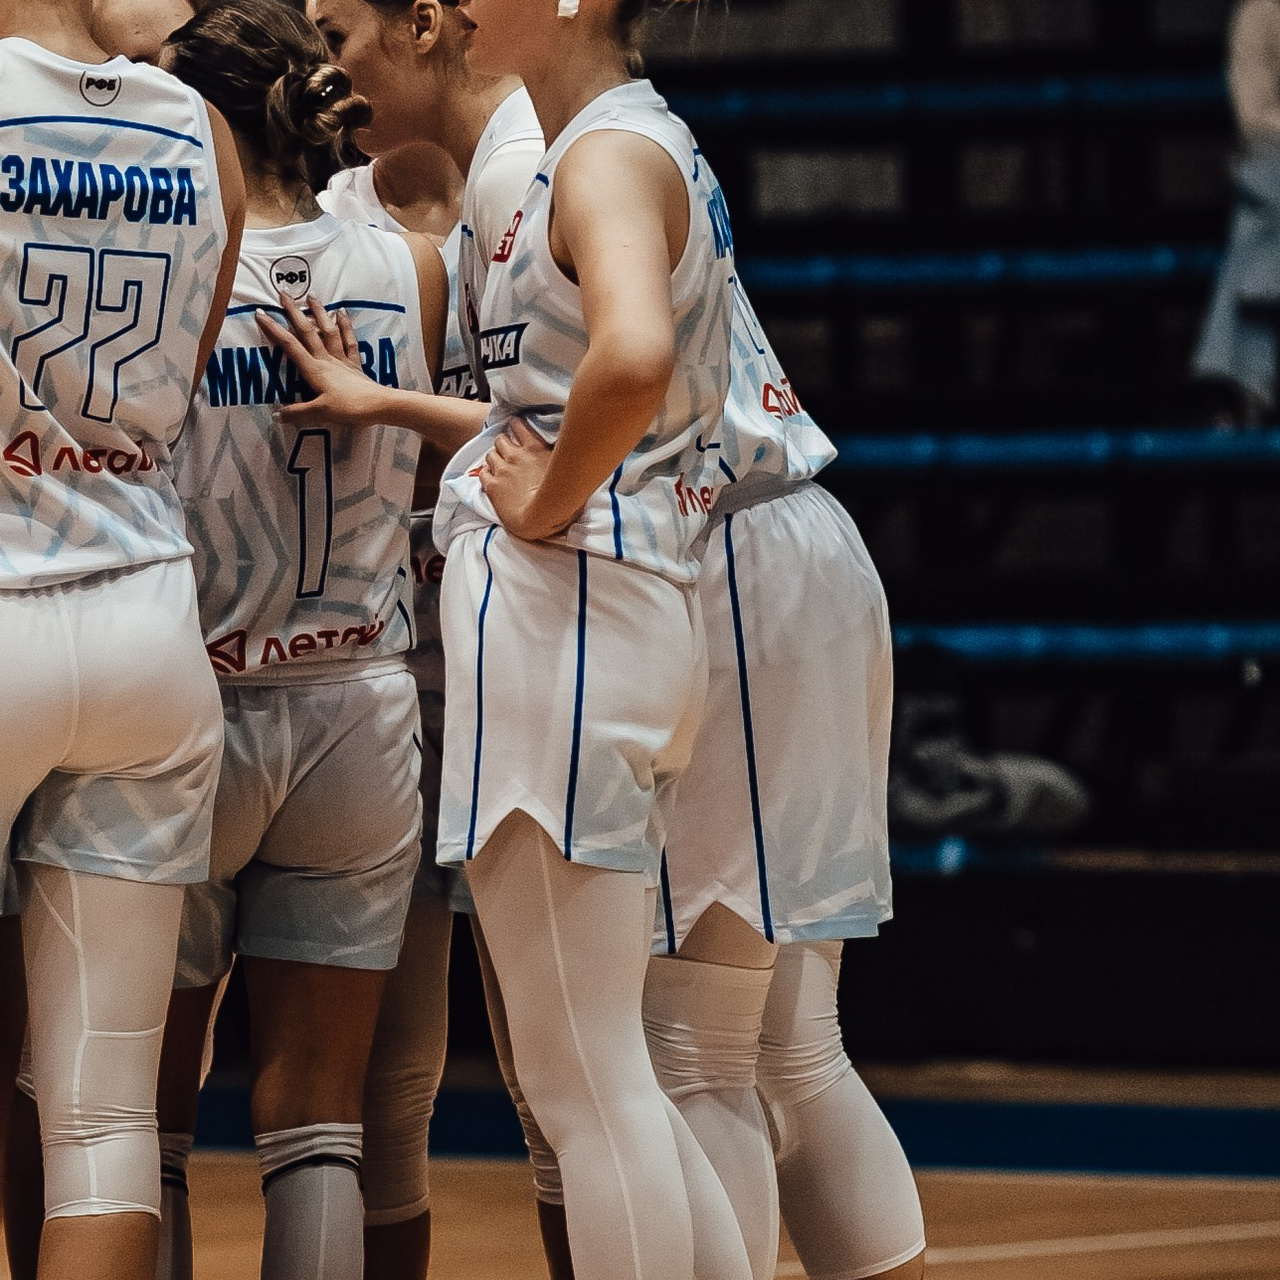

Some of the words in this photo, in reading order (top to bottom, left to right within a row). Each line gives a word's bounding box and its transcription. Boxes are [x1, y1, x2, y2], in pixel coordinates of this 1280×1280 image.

[85, 77, 117, 91] РФБ
[0, 153, 197, 226] ЗАХАРОВА
[275, 270, 308, 285] РФБ
[11, 241, 172, 424] 77
[286, 428, 334, 600] 1
